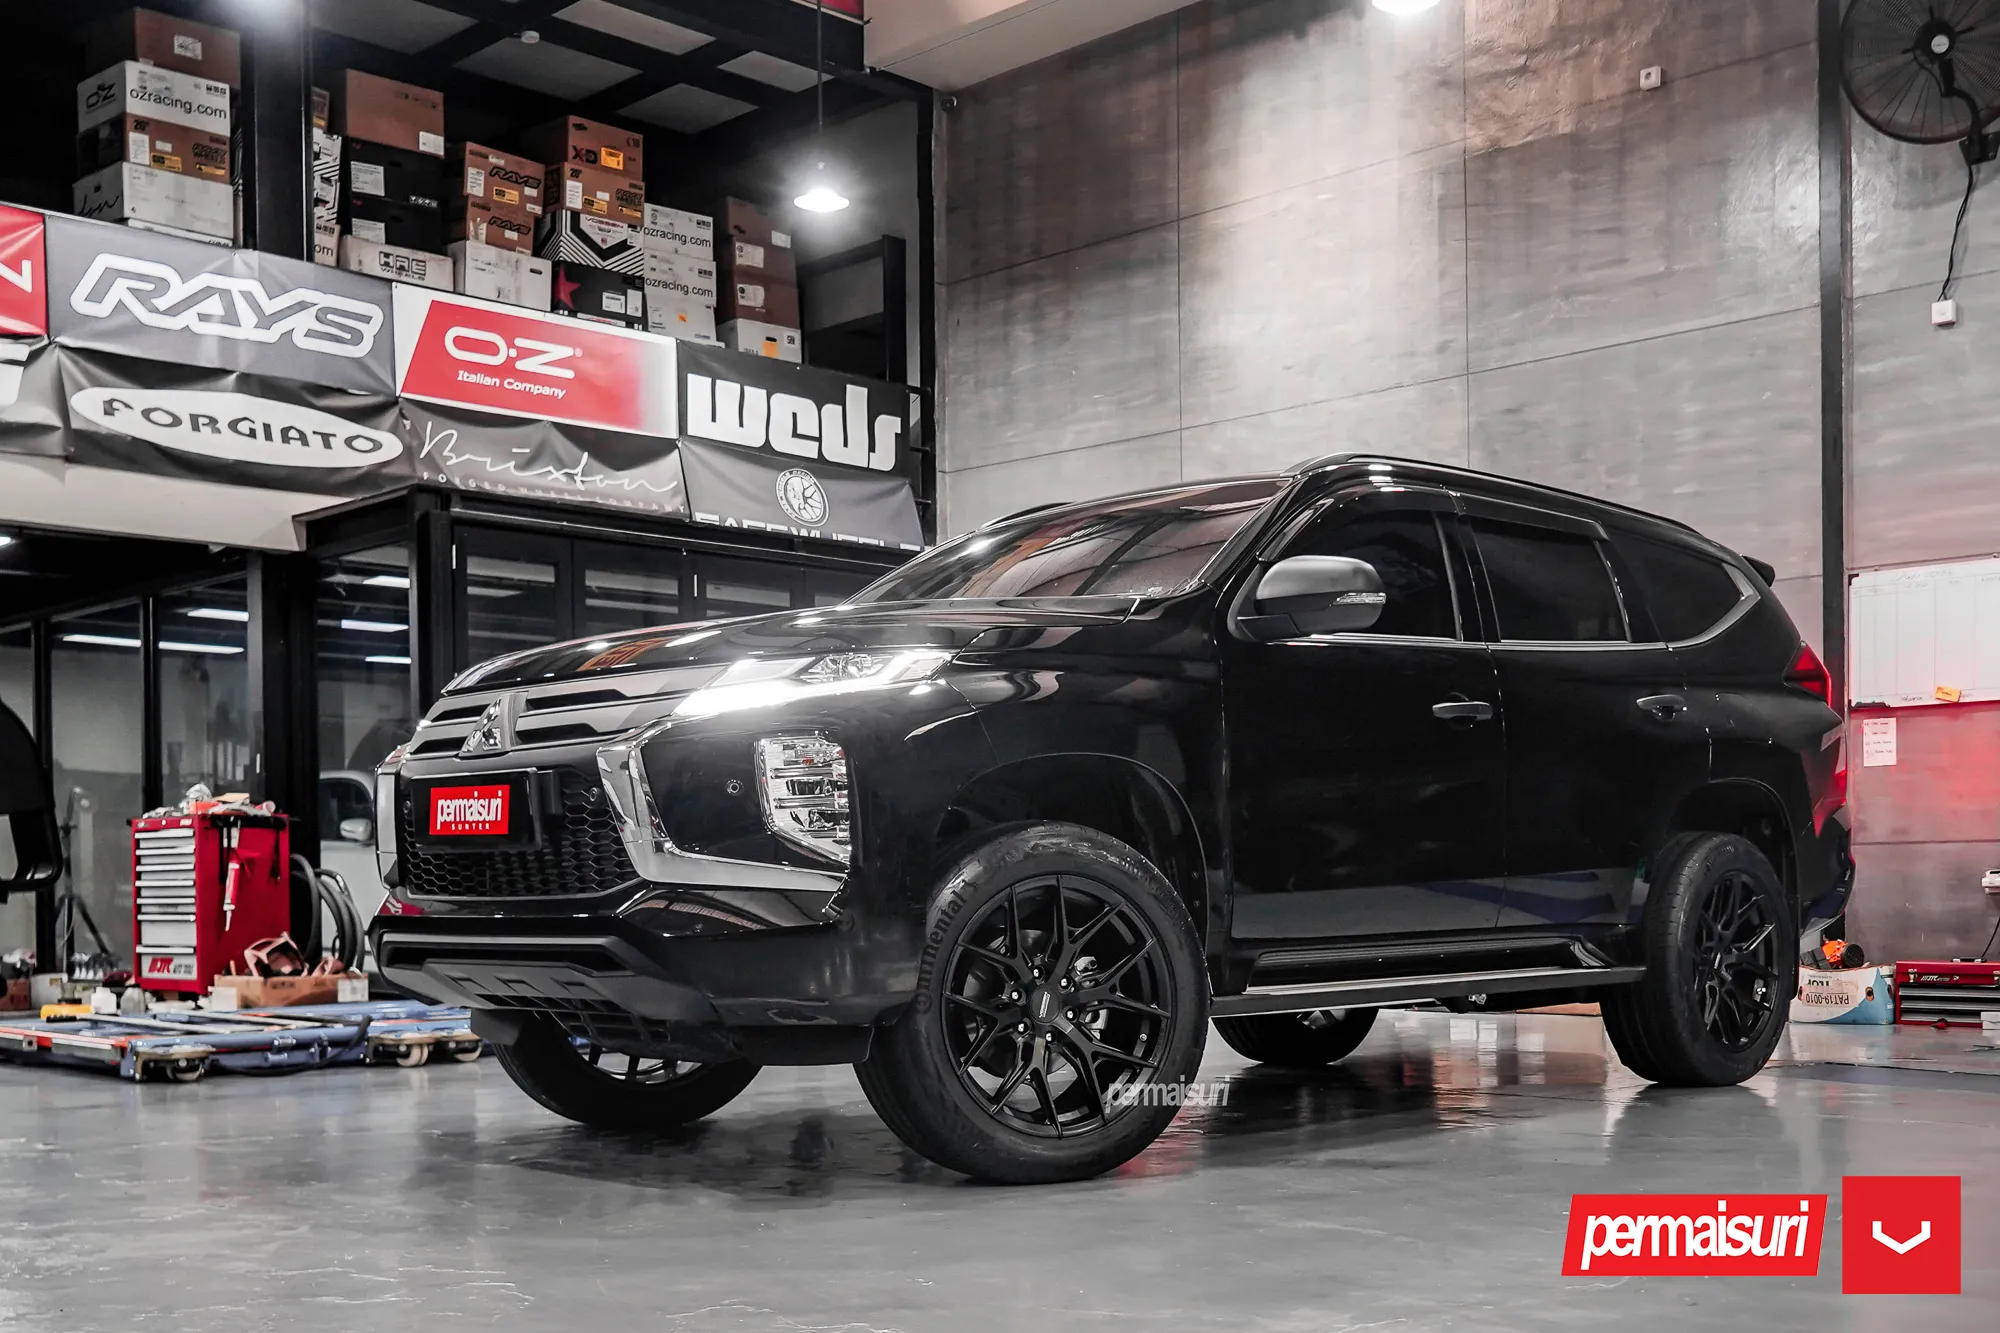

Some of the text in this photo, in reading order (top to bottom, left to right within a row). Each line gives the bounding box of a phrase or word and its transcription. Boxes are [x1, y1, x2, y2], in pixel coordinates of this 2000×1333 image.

[129, 88, 227, 119] ozracing.com
[489, 166, 542, 190] RAYS
[643, 226, 712, 249] ozracing.com
[70, 252, 385, 358] RAYS
[644, 277, 714, 298] ozracing.com
[456, 370, 567, 400] Italian Company
[103, 398, 383, 453] FORGIATO
[687, 373, 901, 471] weds
[420, 421, 678, 492] Brixton
[437, 789, 503, 830] permaisuri
